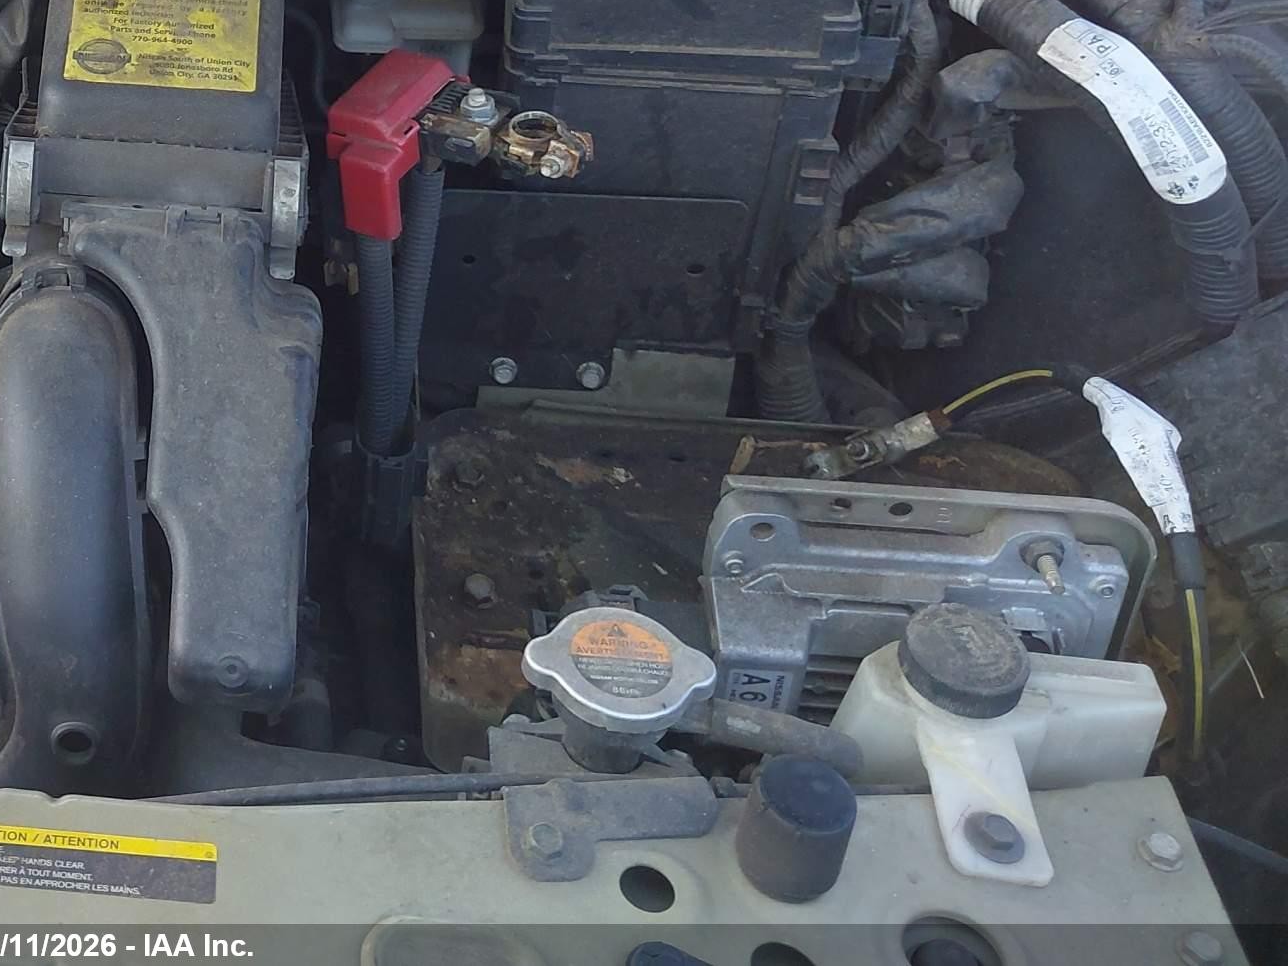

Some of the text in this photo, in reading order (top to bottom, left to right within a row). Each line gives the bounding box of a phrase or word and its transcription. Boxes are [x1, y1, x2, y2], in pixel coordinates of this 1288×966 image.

[113, 17, 127, 25] For
[110, 25, 133, 34] Parts
[134, 27, 152, 35] and
[194, 56, 205, 64] of
[207, 58, 232, 66] Union
[234, 59, 251, 68] City
[198, 72, 211, 80] GA
[32, 832, 39, 842] /
[43, 834, 120, 850] ATTENTION
[21, 857, 53, 868] HANDS
[19, 864, 27, 875] À
[27, 868, 51, 877] TOUT
[0, 876, 19, 884] PAS
[20, 877, 33, 885] EN
[33, 879, 90, 891] APPROCHER
[91, 883, 109, 892] LES
